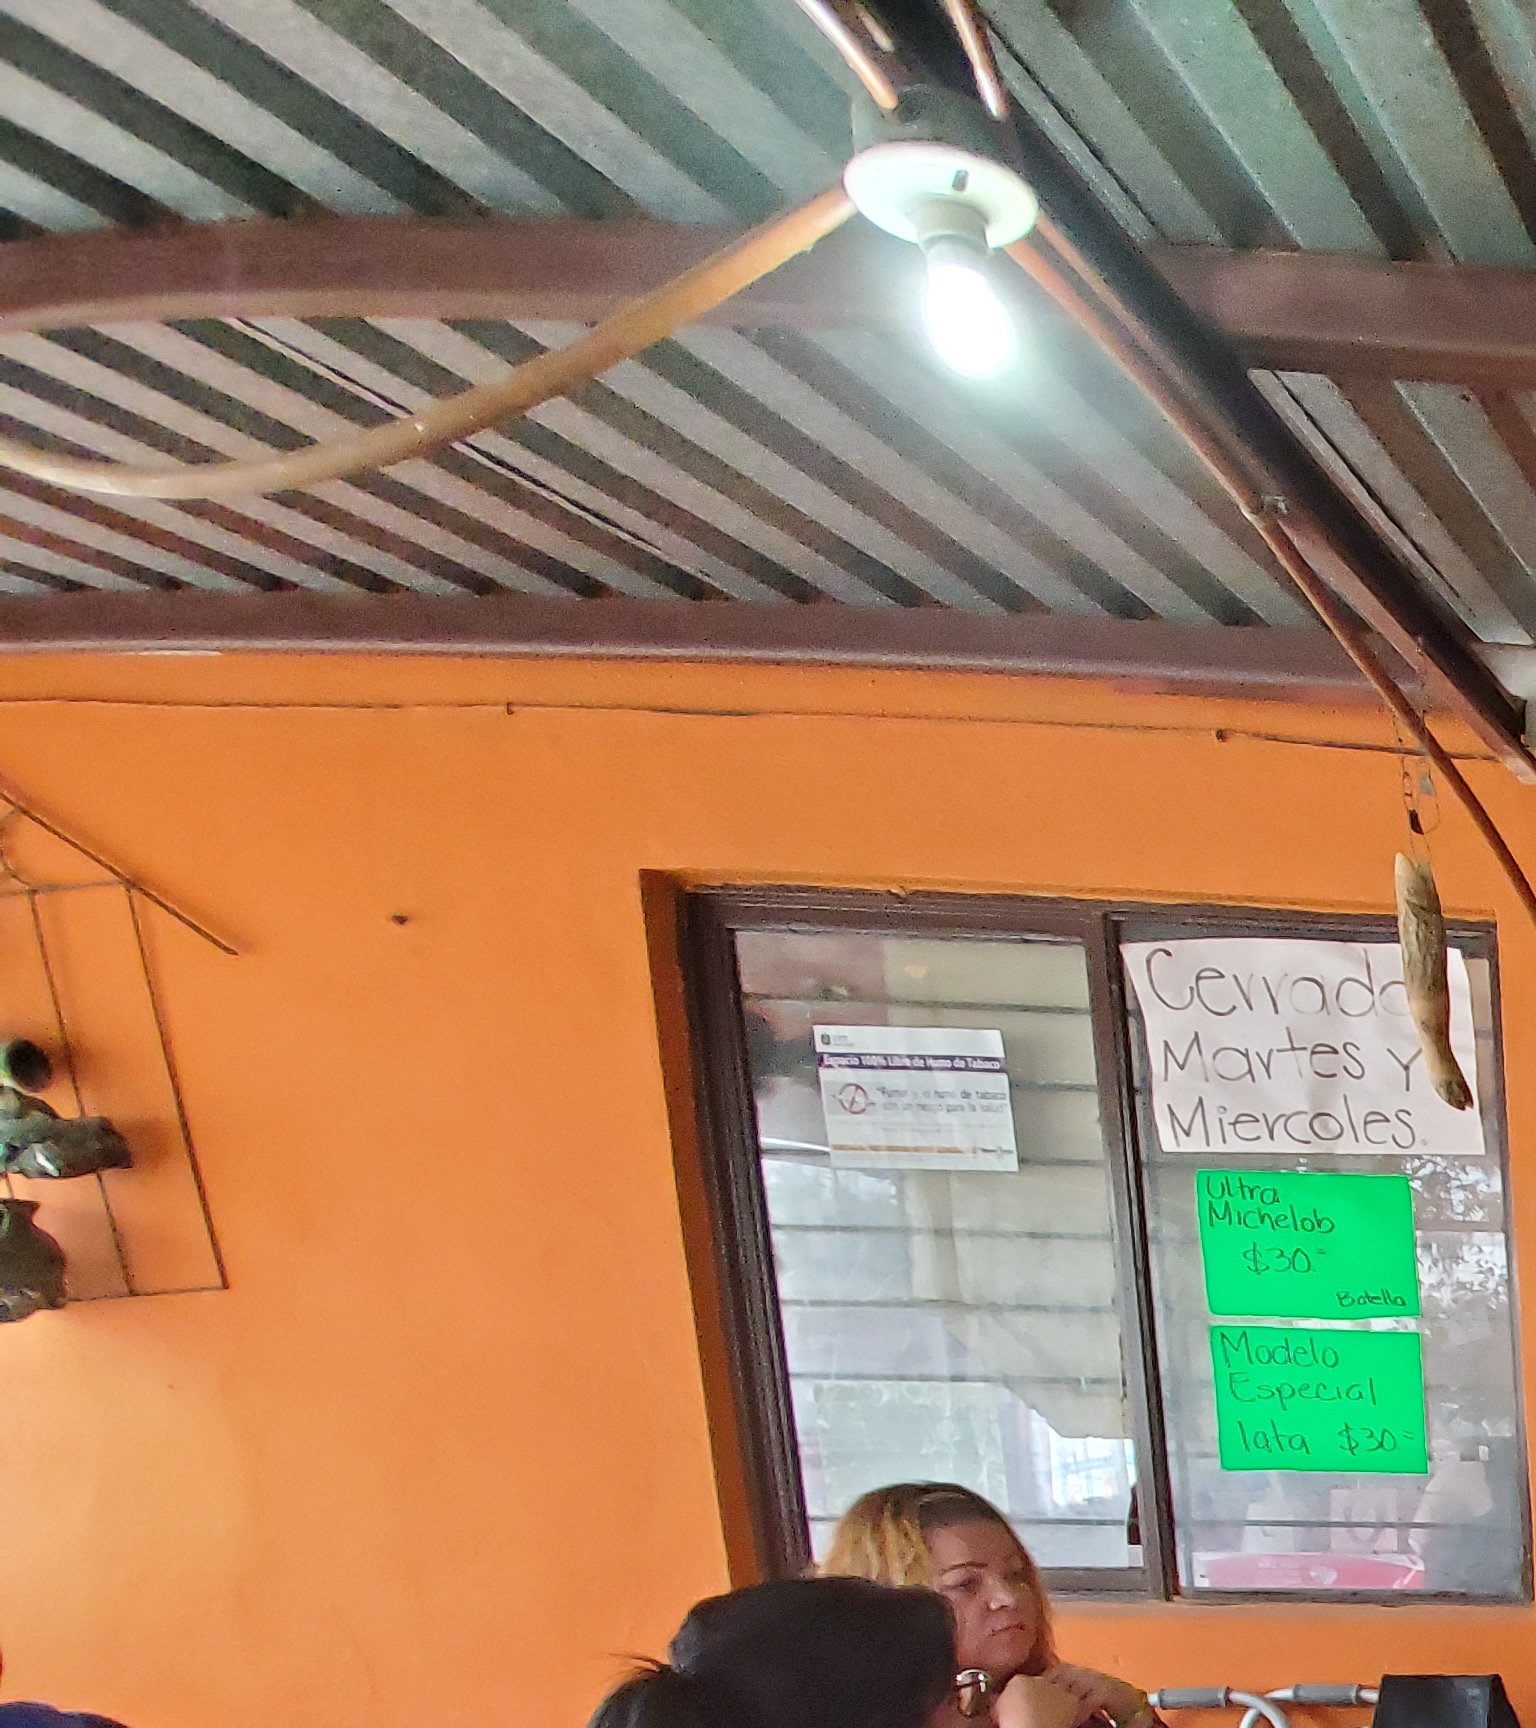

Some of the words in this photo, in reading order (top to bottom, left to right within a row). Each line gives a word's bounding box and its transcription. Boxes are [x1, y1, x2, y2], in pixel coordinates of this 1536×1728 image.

[1163, 1027, 1366, 1084] Martes
[1206, 1176, 1281, 1205] Ultra
[1208, 1200, 1335, 1234] Michelob
[1219, 1330, 1339, 1369] Modelo
[1228, 1371, 1377, 1411] Especial
